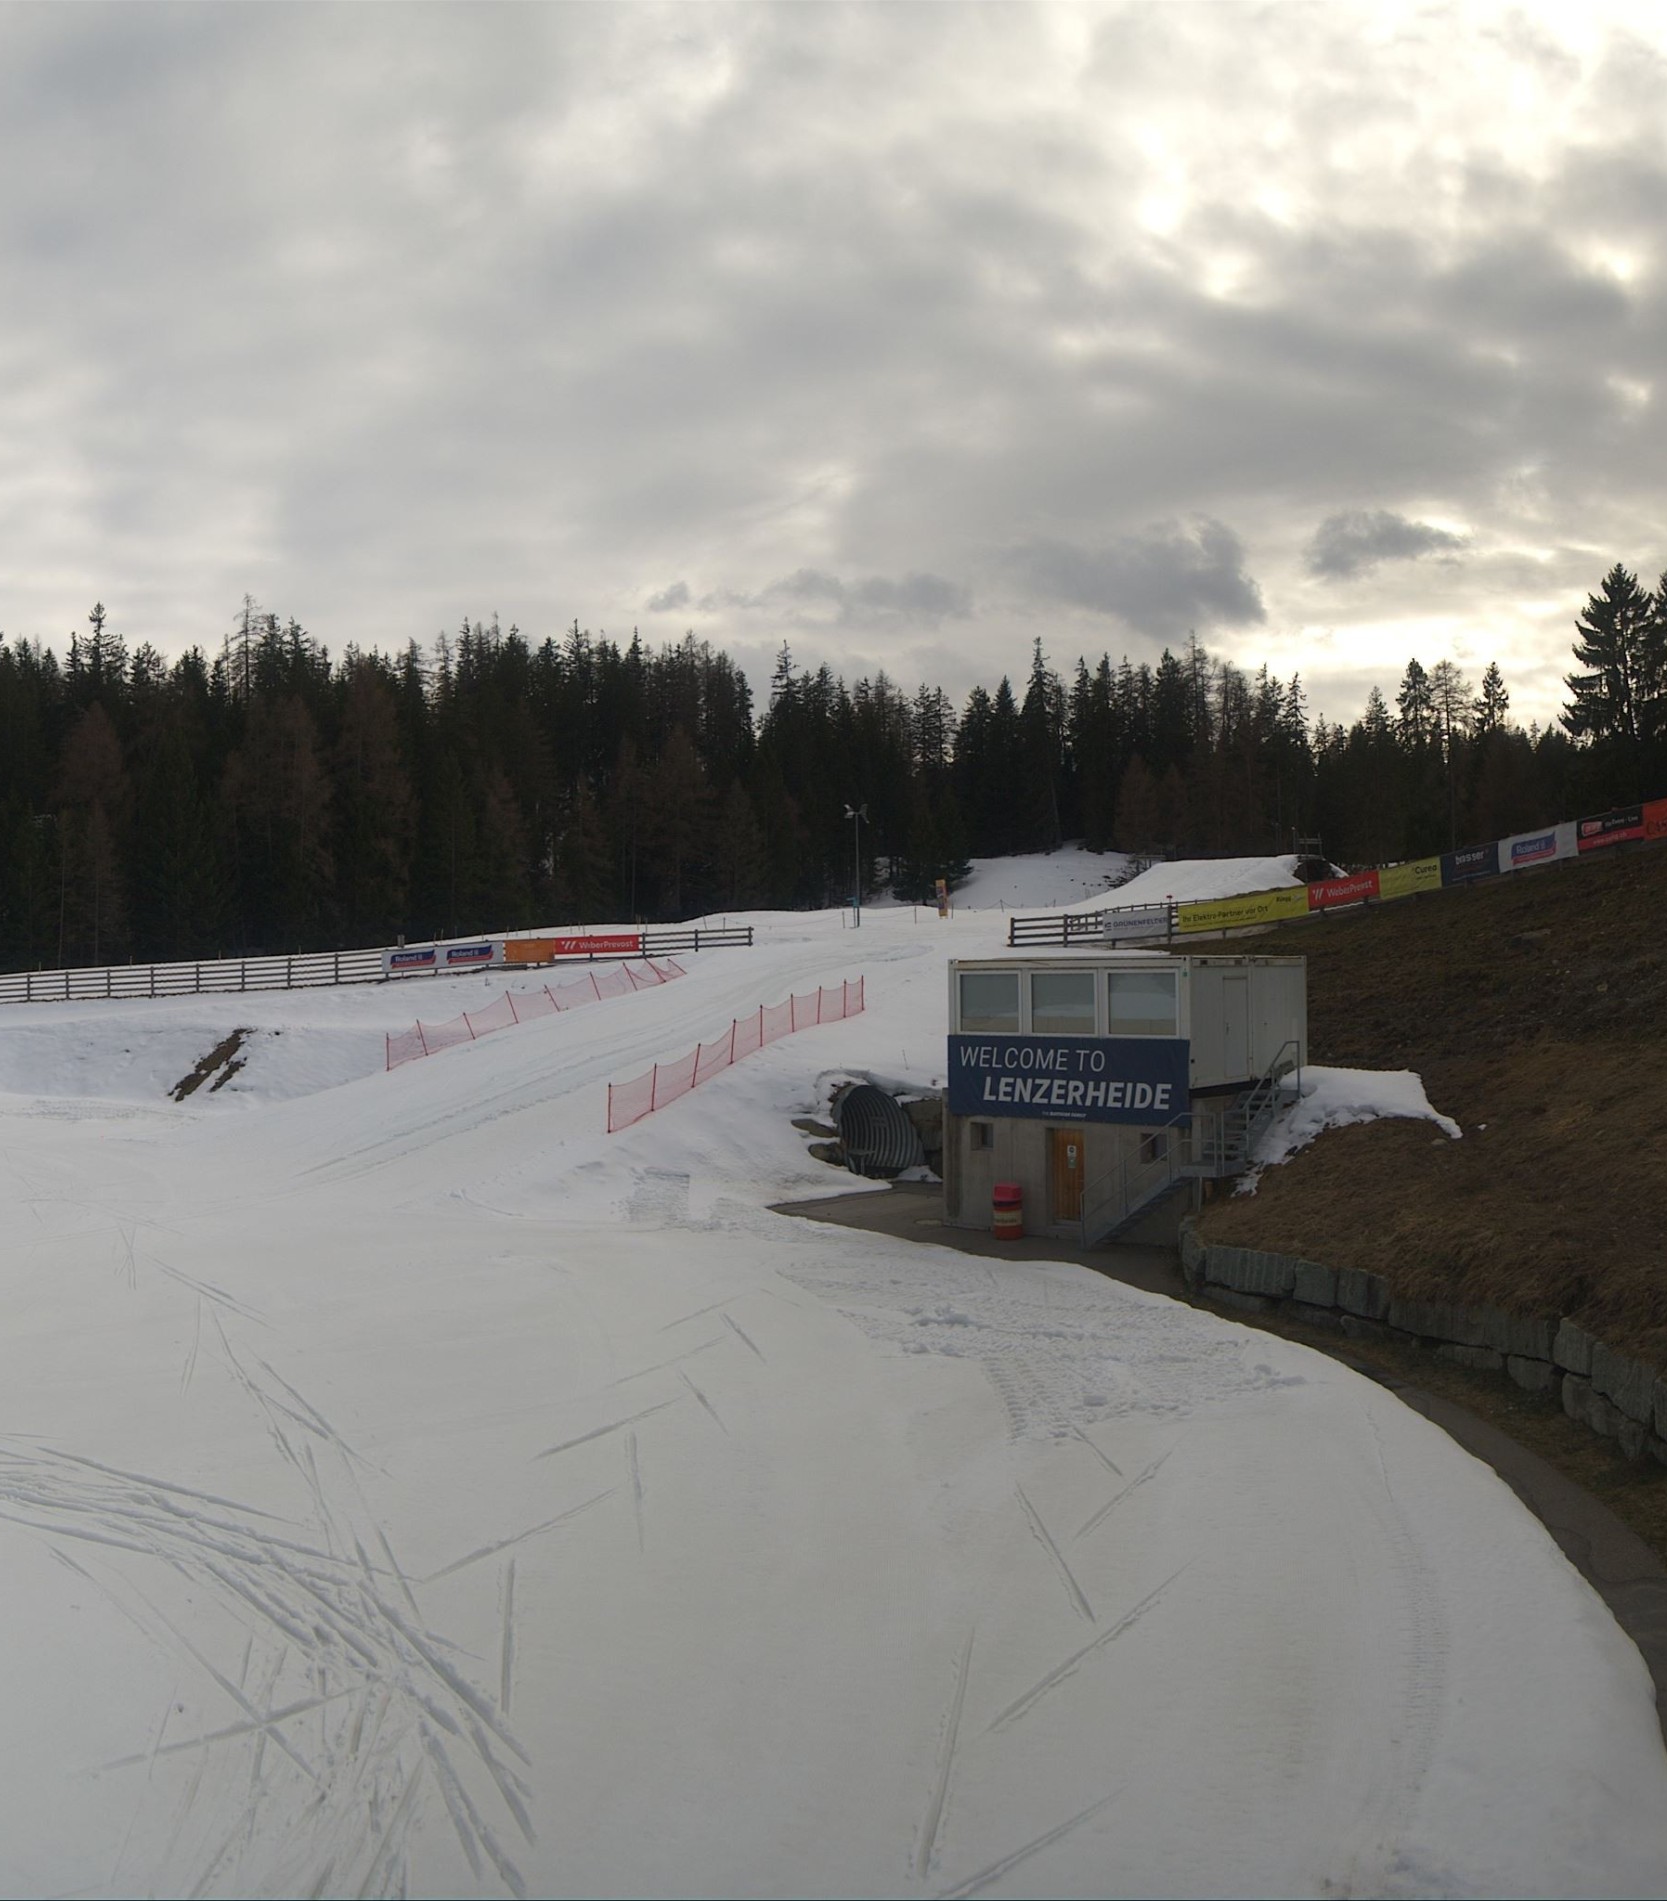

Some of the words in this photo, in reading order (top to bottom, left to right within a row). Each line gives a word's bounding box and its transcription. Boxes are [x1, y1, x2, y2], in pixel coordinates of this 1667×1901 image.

[1516, 841, 1540, 853] Roland
[395, 954, 417, 963] Roland
[451, 948, 474, 957] Roland
[960, 1046, 1069, 1071] WELCOME
[1075, 1050, 1105, 1072] TO
[983, 1076, 1172, 1110] LENZERHEIDE
